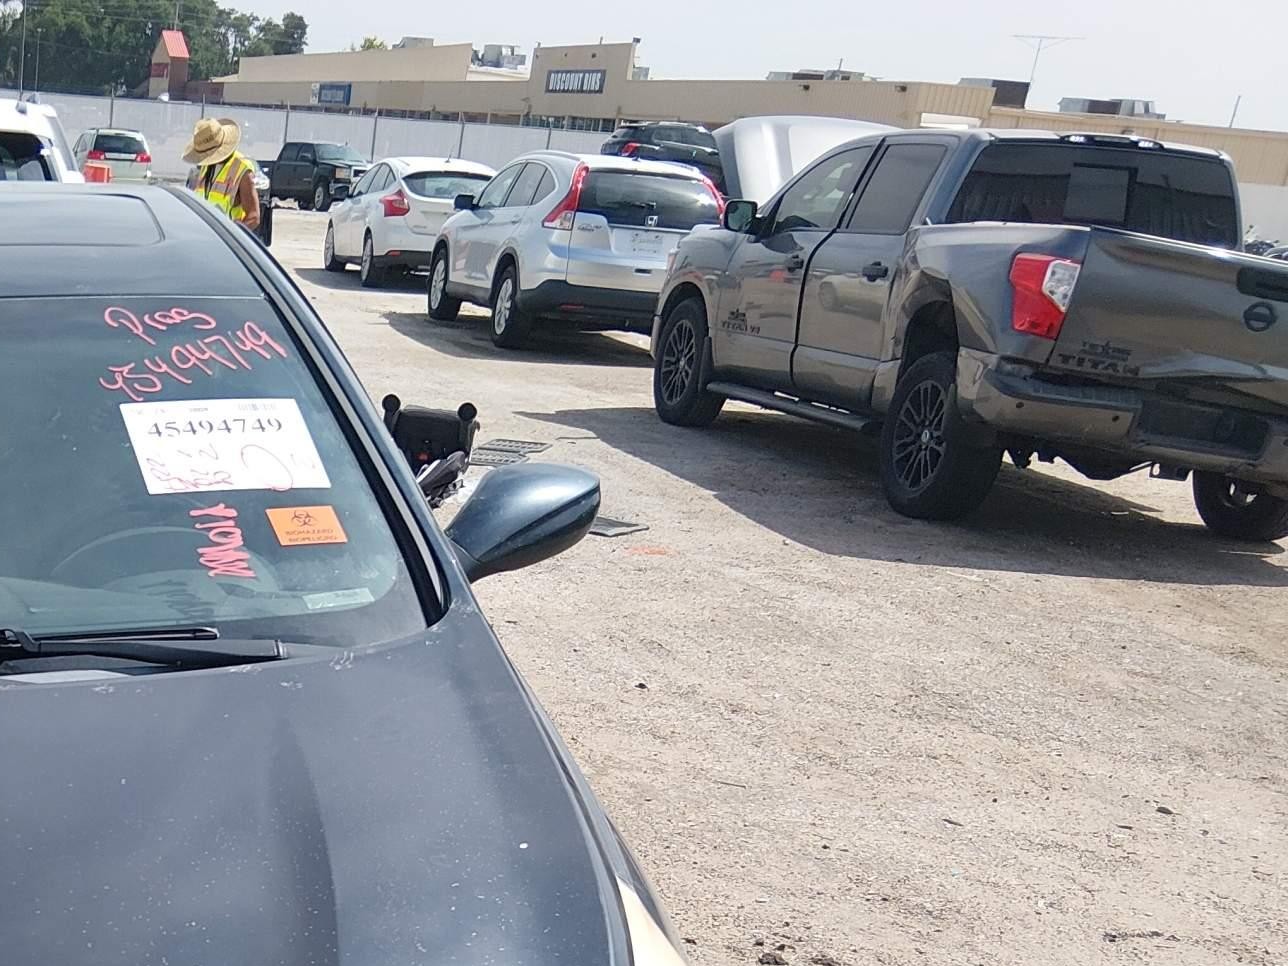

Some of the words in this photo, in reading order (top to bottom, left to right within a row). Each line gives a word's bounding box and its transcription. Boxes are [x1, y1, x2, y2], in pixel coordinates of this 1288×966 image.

[548, 72, 584, 91] DISCOUNT
[582, 72, 602, 91] BINS
[147, 417, 283, 438] 45494749
